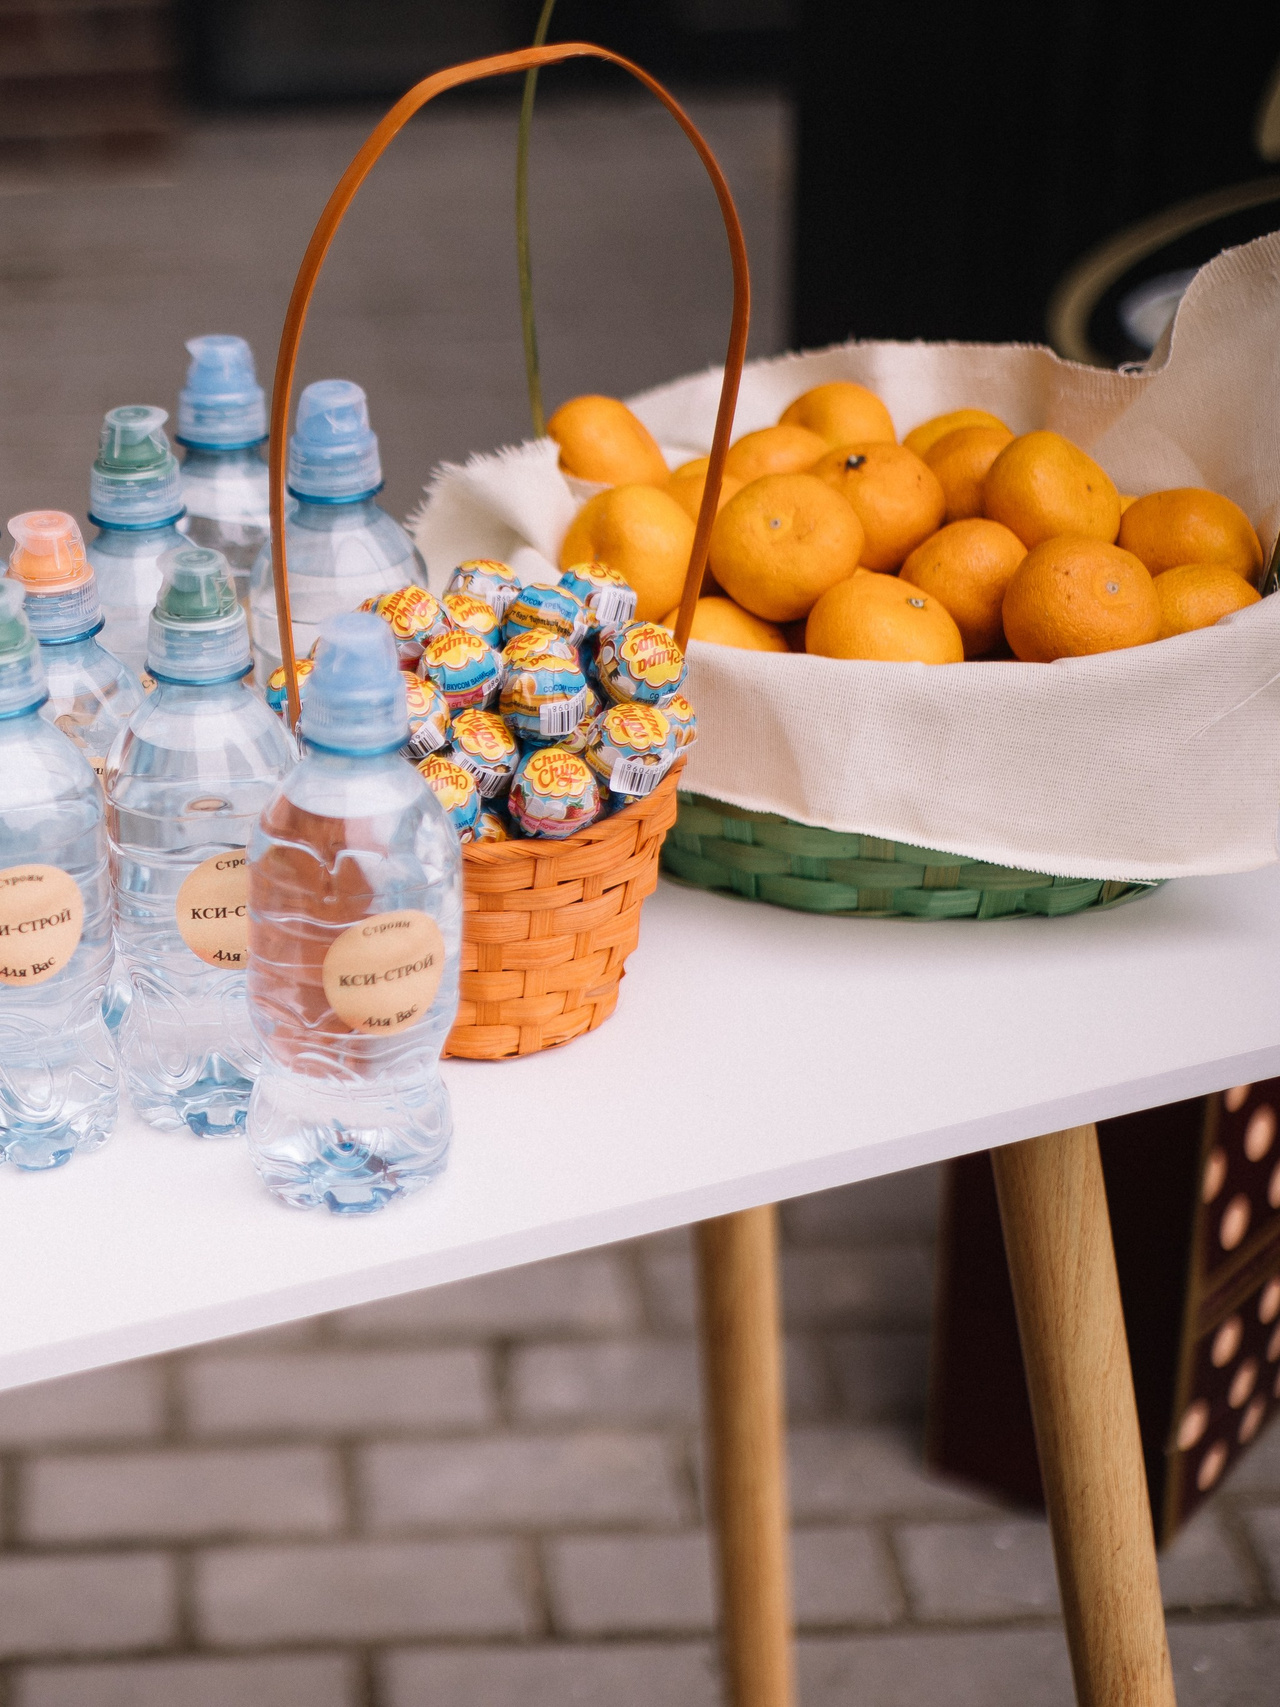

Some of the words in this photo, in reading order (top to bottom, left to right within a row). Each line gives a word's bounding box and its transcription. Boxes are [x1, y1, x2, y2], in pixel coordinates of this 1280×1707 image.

[394, 589, 430, 632] Chups
[433, 636, 482, 660] Chupa
[637, 648, 681, 674] Chupa
[446, 679, 471, 691] ВКУСОМ
[457, 709, 500, 752] Chups
[538, 763, 586, 789] Chups
[215, 858, 246, 871] Стро
[190, 905, 246, 920] КСИ-С
[361, 920, 411, 937] Строим
[31, 956, 57, 976] Вас
[212, 949, 242, 962] Для
[338, 953, 434, 987] КСИ-СТРОЙ
[362, 1015, 392, 1028] Для
[395, 1003, 419, 1024] Вас
